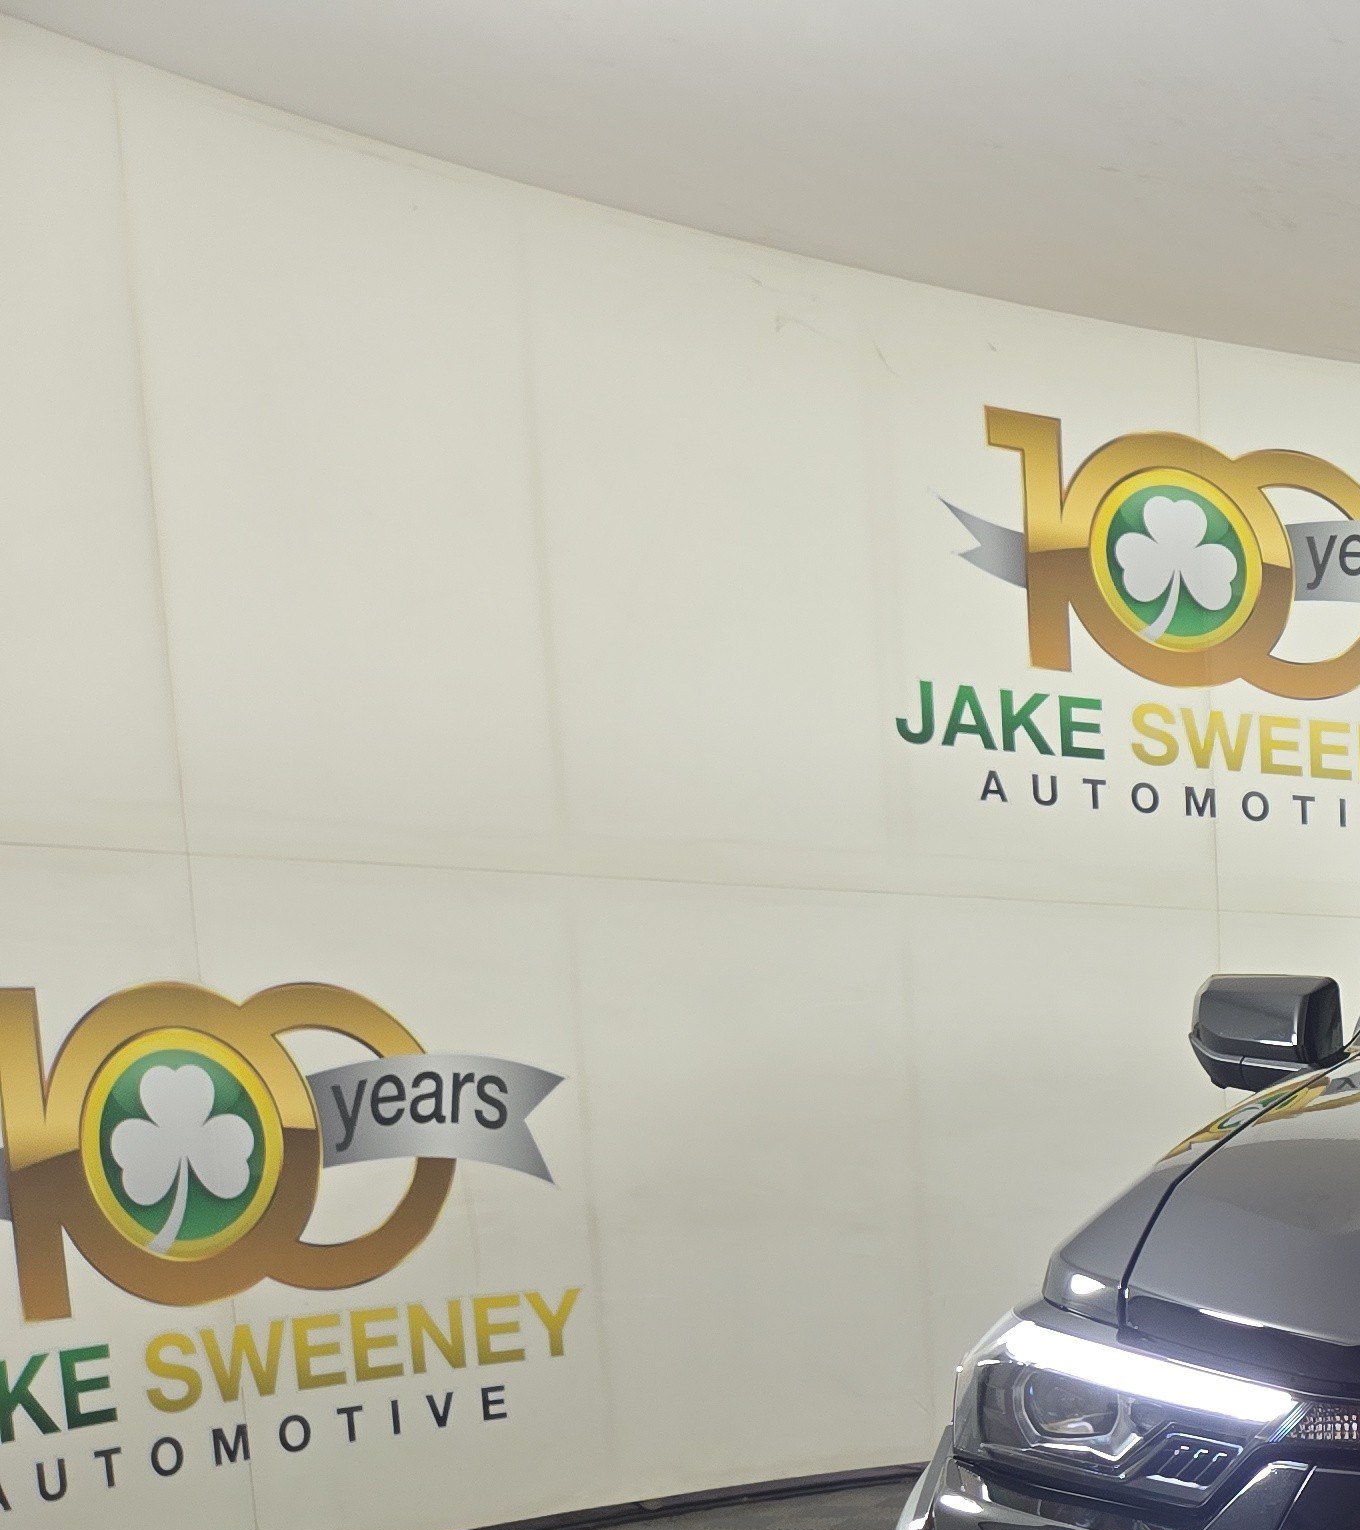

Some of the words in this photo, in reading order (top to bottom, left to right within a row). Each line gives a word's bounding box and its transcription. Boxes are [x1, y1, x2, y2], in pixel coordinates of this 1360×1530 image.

[895, 679, 1106, 760] JAKE
[331, 1070, 509, 1153] years
[145, 1288, 581, 1415] SWEENEY
